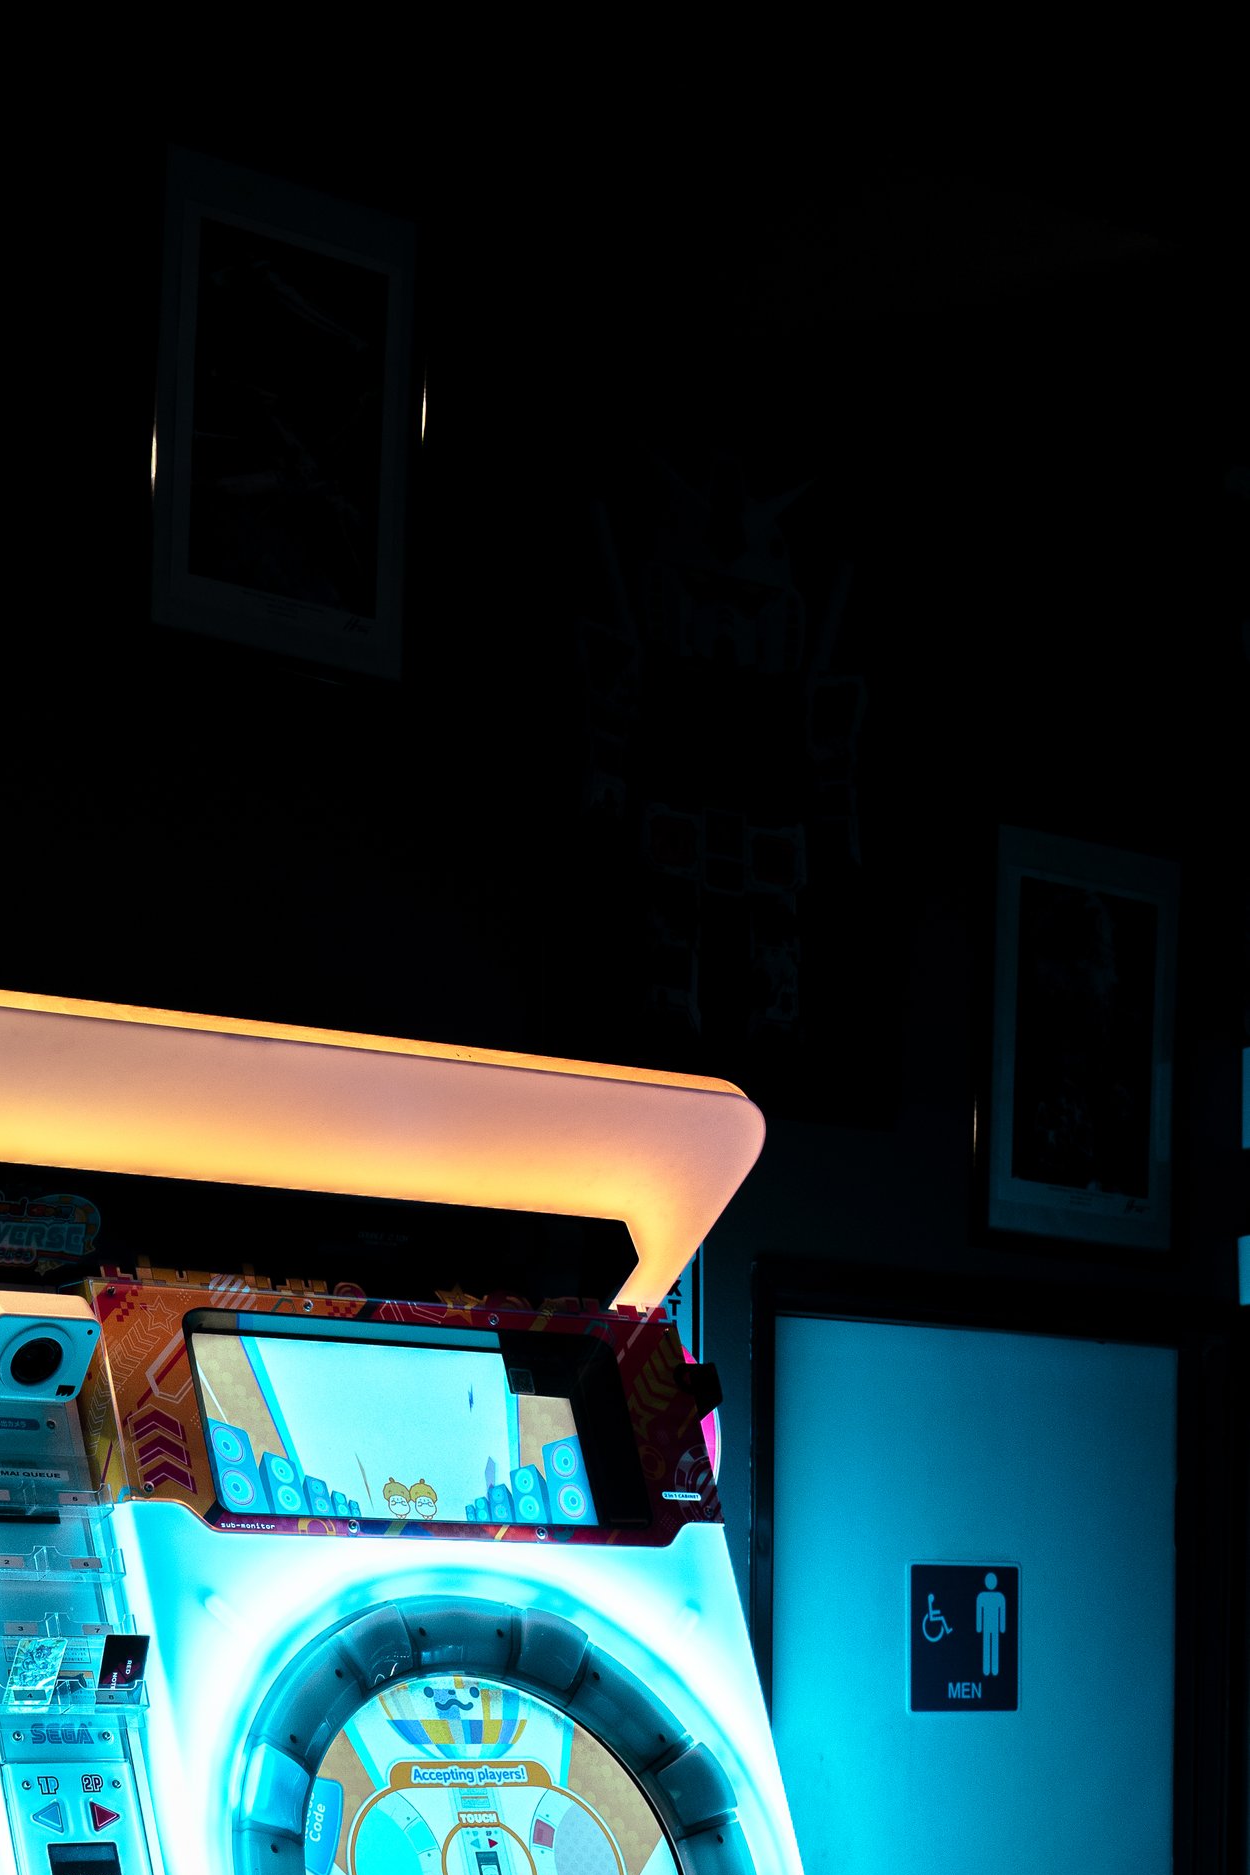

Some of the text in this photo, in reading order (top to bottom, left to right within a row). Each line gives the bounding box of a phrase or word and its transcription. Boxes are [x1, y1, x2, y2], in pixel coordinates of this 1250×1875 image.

[23, 1471, 61, 1479] QUEUE
[220, 1522, 276, 1530] sub-monitor
[125, 1660, 133, 1675] RED
[948, 1682, 982, 1699] MEN
[30, 1722, 94, 1745] SEGA
[81, 1774, 104, 1793] 2P
[413, 1768, 526, 1783] Accepting players!
[37, 1776, 59, 1795] 1P
[309, 1802, 326, 1843] Code
[460, 1813, 497, 1824] TOUCH
